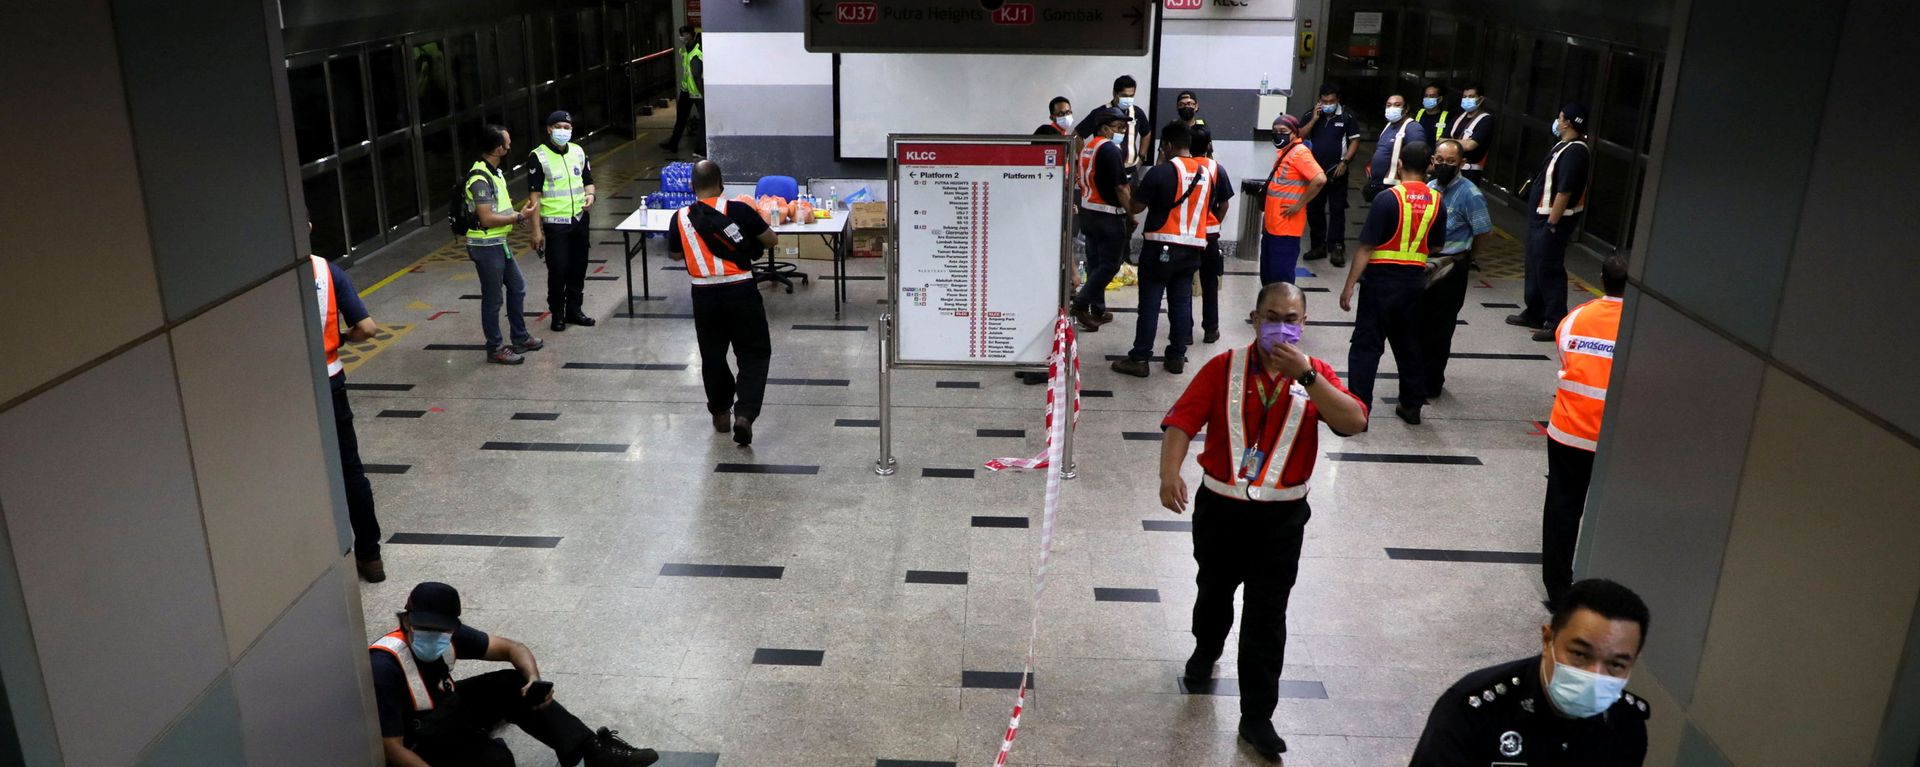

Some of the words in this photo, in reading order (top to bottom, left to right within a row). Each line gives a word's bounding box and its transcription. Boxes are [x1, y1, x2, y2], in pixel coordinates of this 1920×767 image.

[837, 5, 875, 20] KJ37
[883, 6, 923, 20] Putra
[927, 6, 983, 24] Heights
[1000, 6, 1028, 22] KJ1
[1042, 7, 1103, 22] Gombak
[906, 151, 936, 160] KLCC
